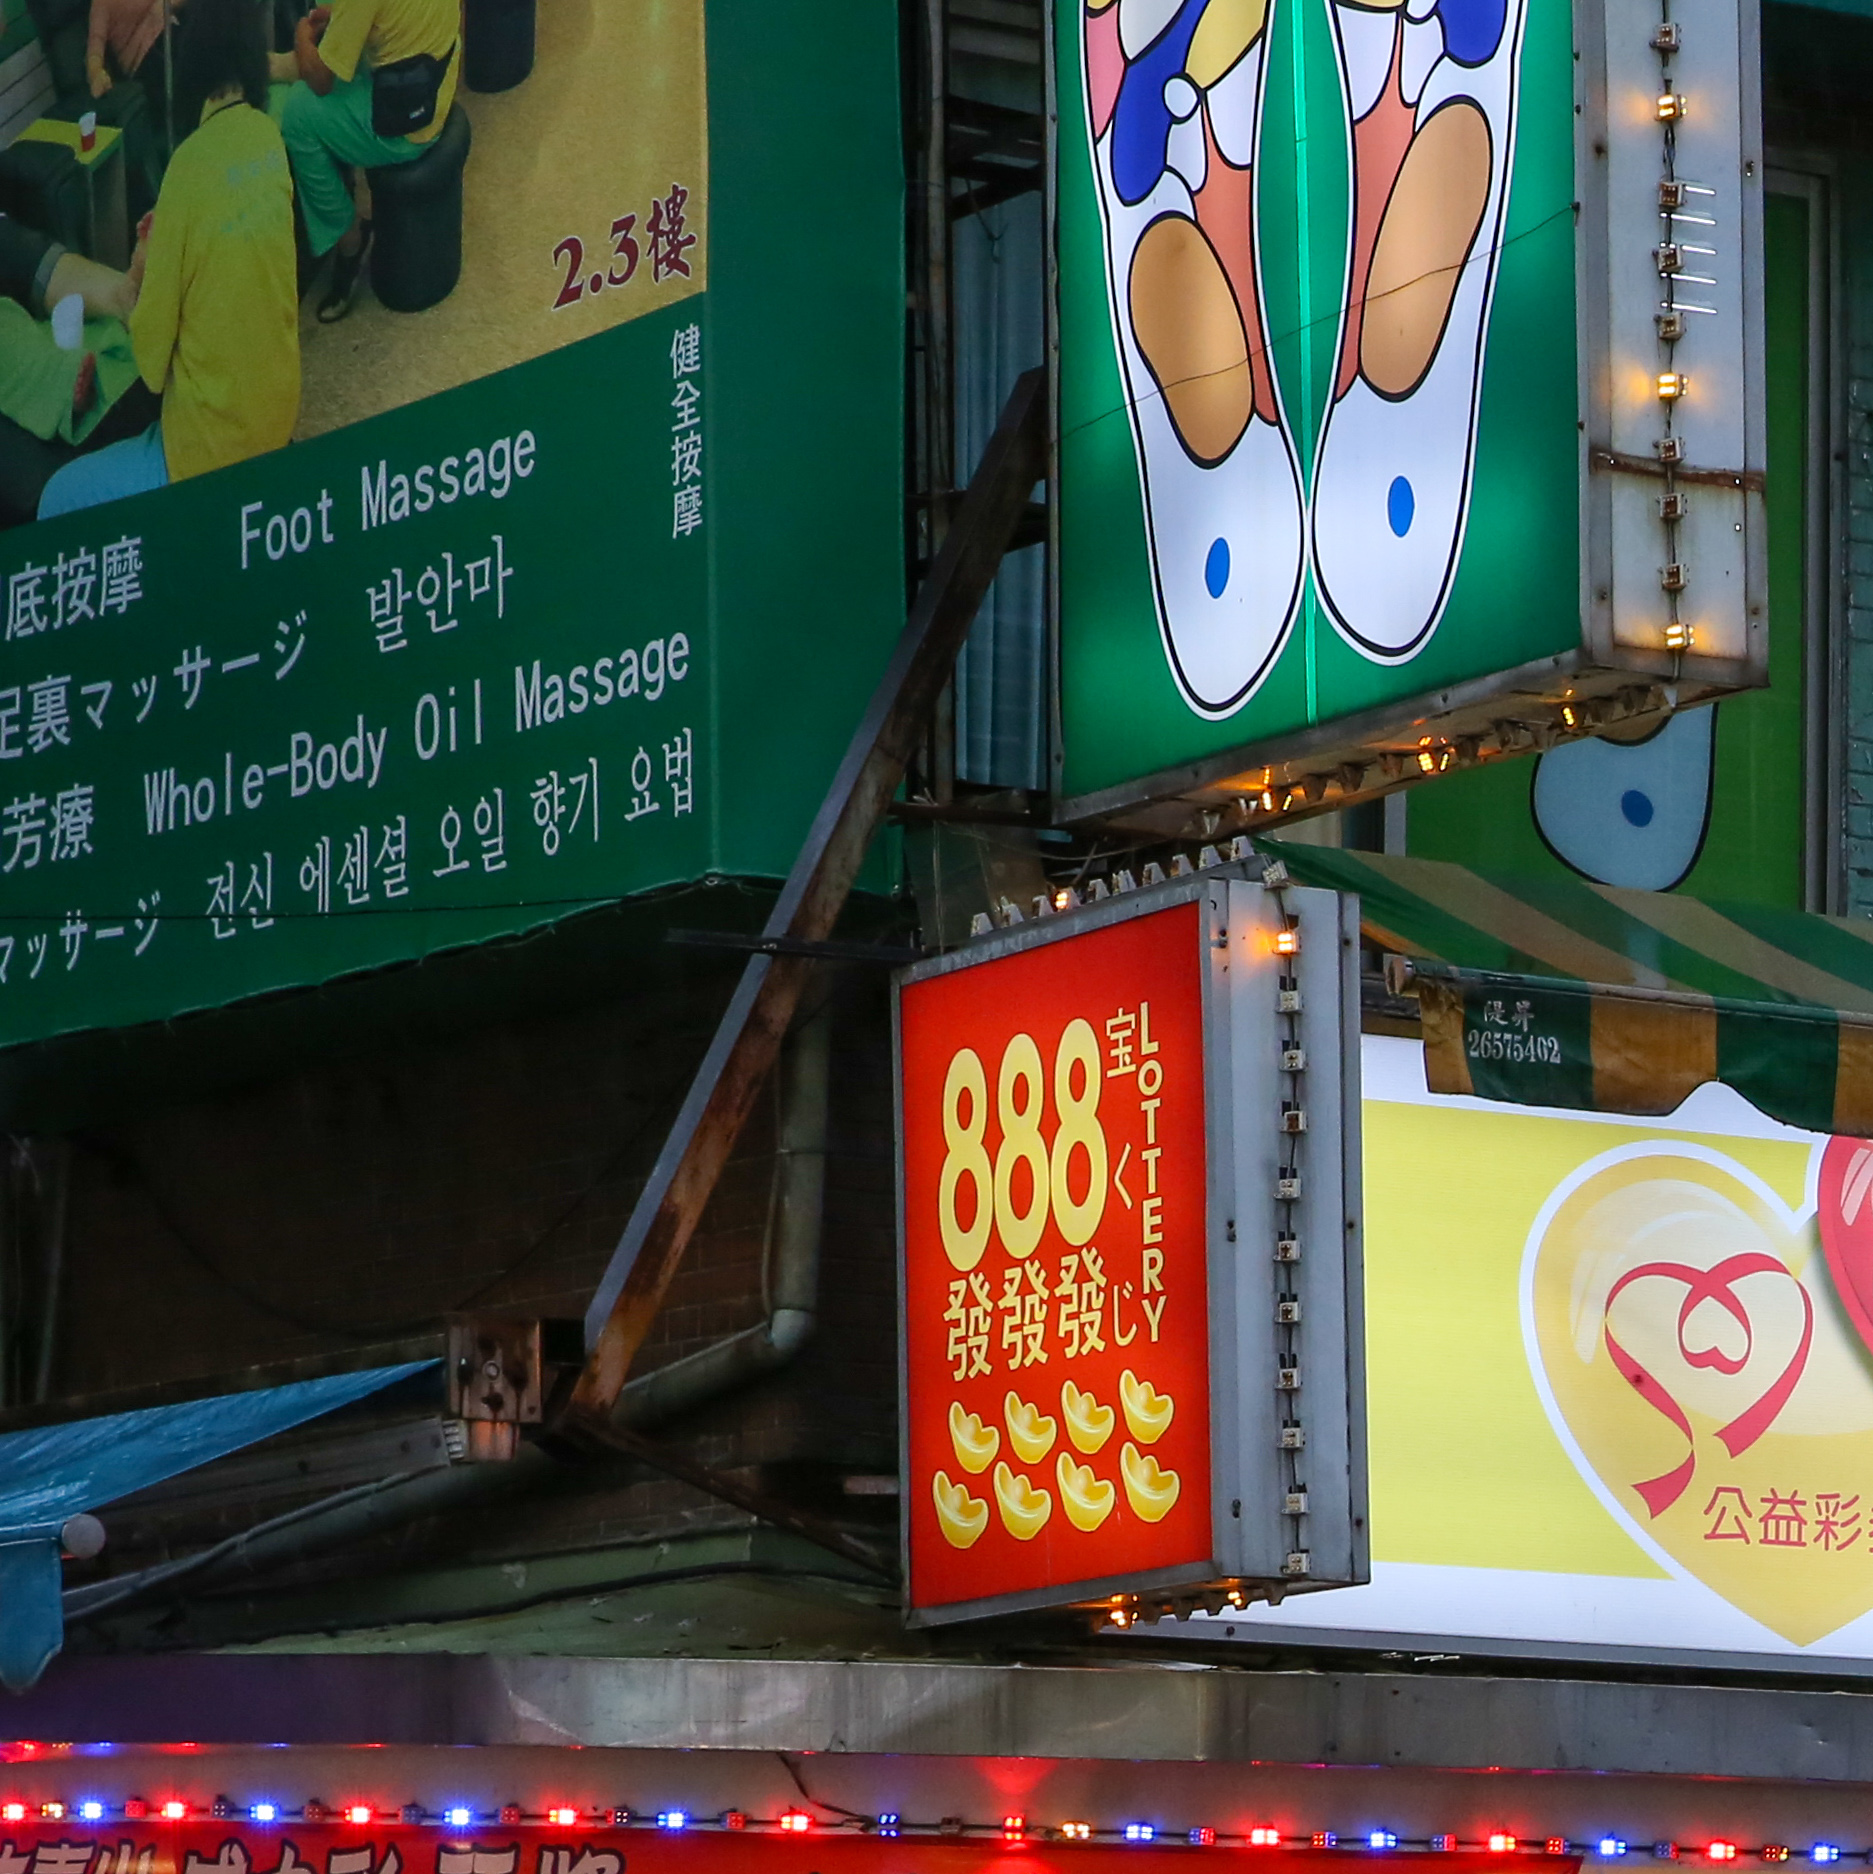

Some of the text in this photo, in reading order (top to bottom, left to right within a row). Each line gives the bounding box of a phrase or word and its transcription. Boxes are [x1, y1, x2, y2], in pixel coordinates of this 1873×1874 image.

[551, 183, 695, 309] 2.3樓
[239, 428, 537, 569] Foot Massage
[669, 323, 703, 540] 健全按摩
[4, 534, 144, 643] 底按摩
[367, 533, 514, 653] 발안마
[143, 625, 690, 836] Whole-Body Oil Massage
[2, 780, 95, 873] 芳療
[204, 850, 275, 939] 전신
[432, 786, 506, 878] 오일
[530, 757, 599, 856] 향기
[623, 726, 695, 821] 요법
[1468, 1030, 1561, 1064] 26575402
[938, 1018, 1108, 1273] 888
[1137, 1001, 1166, 1344] LOTTERY
[944, 1245, 1106, 1382] 發發發
